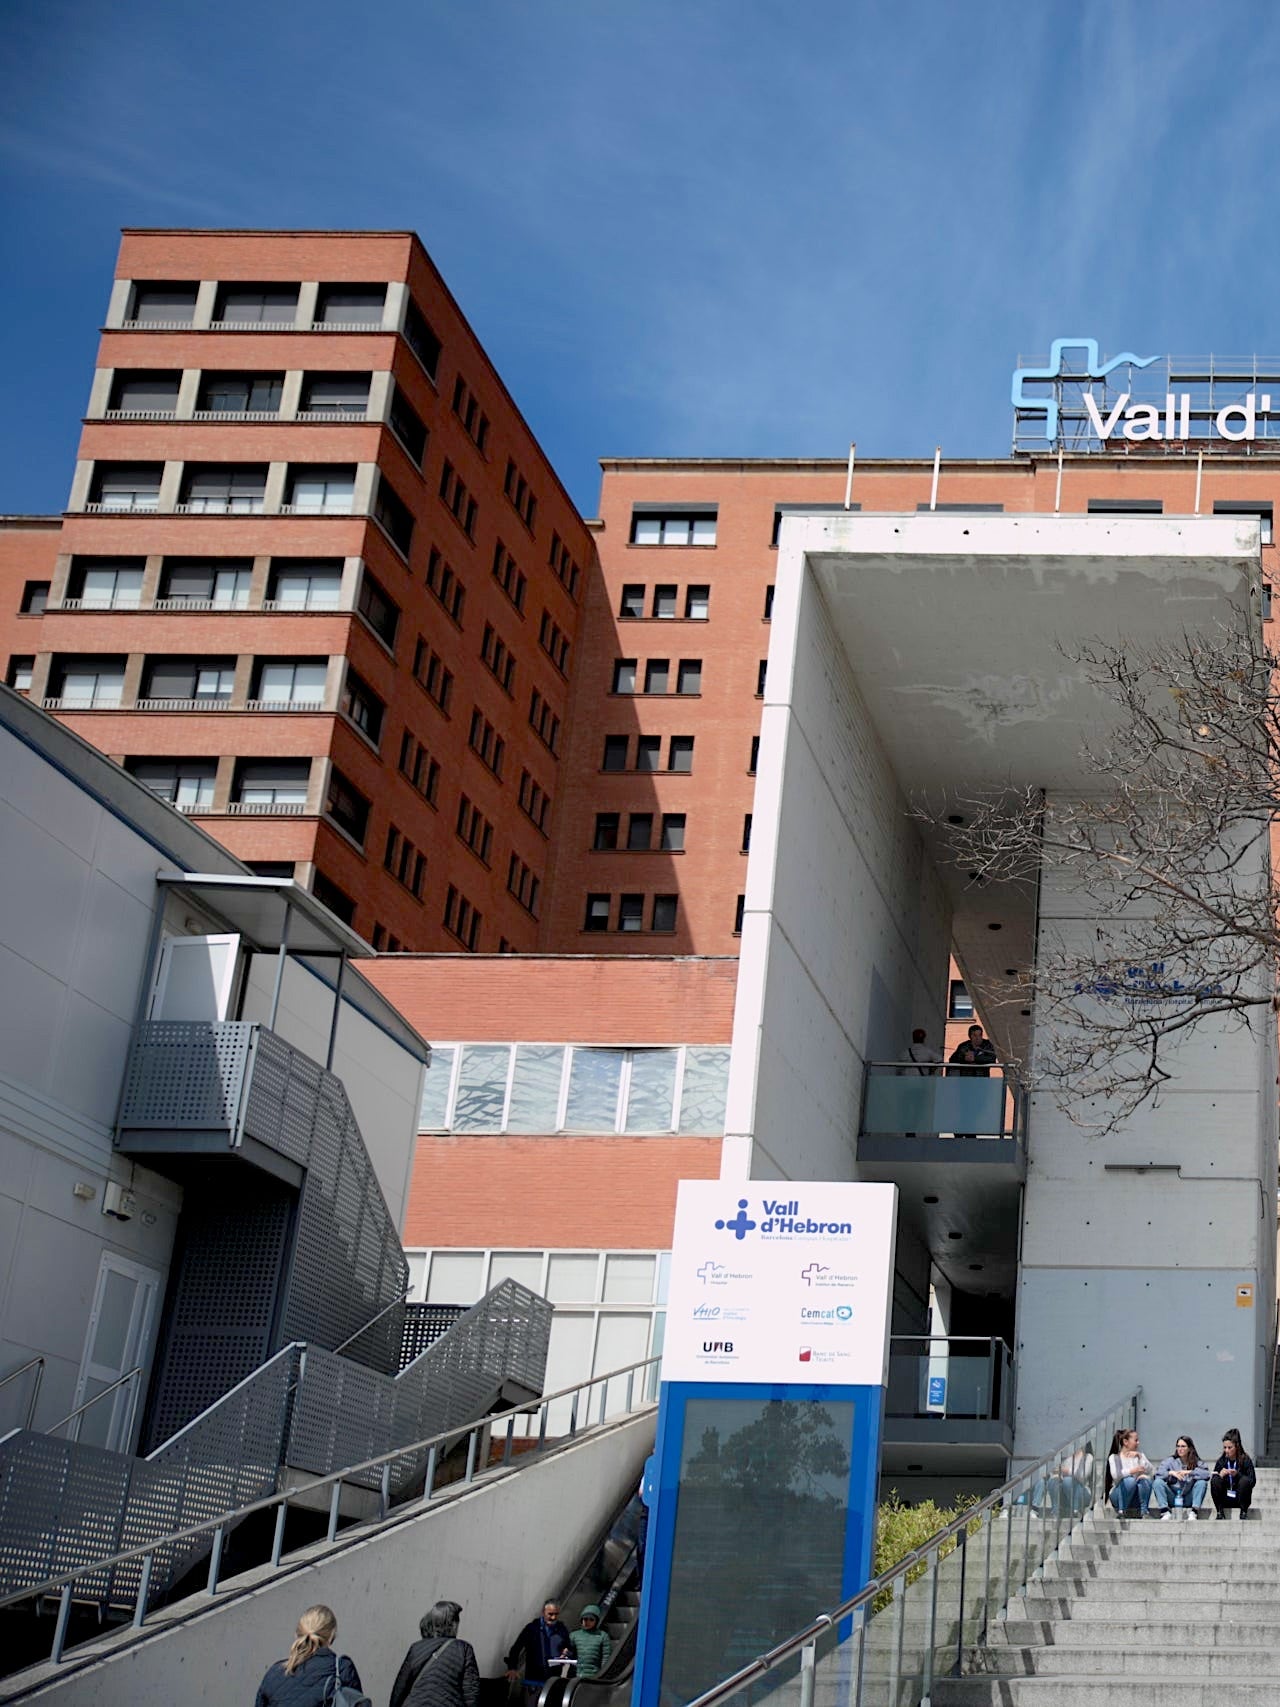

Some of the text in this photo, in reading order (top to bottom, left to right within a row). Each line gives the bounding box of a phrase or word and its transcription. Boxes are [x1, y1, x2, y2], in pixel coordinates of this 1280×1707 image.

[1082, 393, 1190, 441] Vall
[762, 1200, 799, 1216] Vall
[760, 1218, 852, 1234] d’Hebron
[801, 1307, 835, 1319] Cemcat
